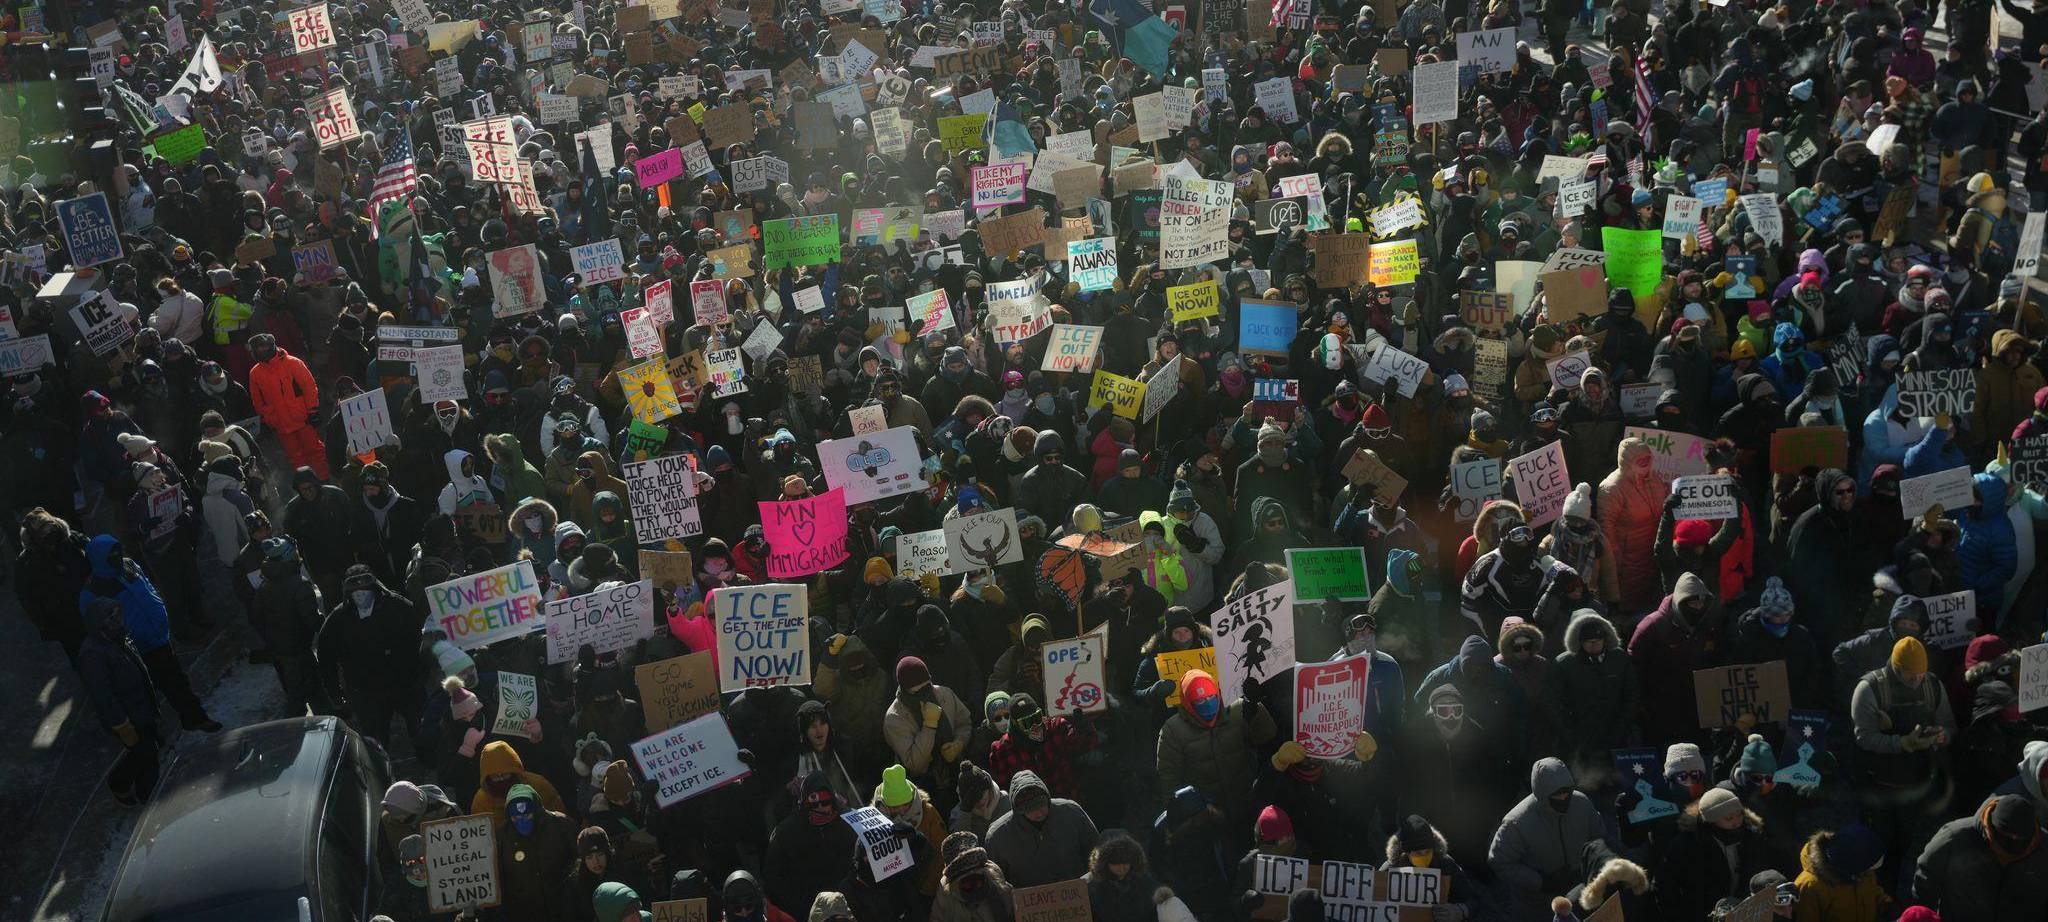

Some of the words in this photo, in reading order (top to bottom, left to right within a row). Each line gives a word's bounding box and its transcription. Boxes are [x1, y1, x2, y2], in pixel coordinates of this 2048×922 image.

[406, 8, 424, 22] FOR
[1205, 2, 1237, 12] PLEAD
[1213, 10, 1232, 21] THE
[294, 12, 325, 31] ICE
[408, 16, 429, 30] GOOD
[1472, 34, 1501, 49] MN
[280, 48, 296, 58] ICE
[92, 62, 110, 76] ICE
[936, 52, 973, 76] ICE
[1205, 72, 1222, 82] ICE
[318, 118, 352, 140] OUT!
[736, 160, 764, 173] ICE
[980, 168, 999, 181] LIKE
[1000, 166, 1014, 179] MY
[735, 169, 764, 183] OUT
[976, 177, 1006, 191] RIGHTS
[1006, 174, 1023, 187] WITH
[978, 190, 990, 201] NO
[992, 188, 1008, 199] ICE
[1167, 177, 1182, 189] NO
[1214, 182, 1226, 195] IS
[1284, 175, 1321, 198] ICE
[1216, 197, 1230, 207] ON
[1564, 192, 1581, 204] ICE
[1674, 200, 1695, 211] FIGHT
[1164, 200, 1201, 215] STOLEN
[76, 210, 99, 231] BE
[1164, 216, 1181, 226] IN
[1186, 215, 1201, 226] ON
[1204, 208, 1222, 222] IT:
[72, 225, 115, 249] BETTER
[578, 248, 593, 257] MN
[595, 244, 617, 256] NICE
[1070, 240, 1104, 255] ICE
[1164, 249, 1185, 260] NOT
[1187, 247, 1200, 258] IN
[1200, 245, 1213, 255] ON
[293, 246, 329, 268] MN
[579, 258, 598, 271] NOT
[600, 252, 622, 266] FOR
[1072, 250, 1116, 273] ALWAYS
[1560, 252, 1605, 263] FUCK
[2016, 258, 2036, 270] NO
[586, 267, 617, 283] ICE
[1073, 268, 1117, 289] MELTS
[1174, 290, 1190, 300] ICE
[1192, 286, 1211, 297] OUT
[1468, 294, 1508, 308] ICE
[81, 296, 114, 326] ICE
[1175, 296, 1214, 312] NOW!
[1466, 307, 1506, 323] OUT
[86, 322, 111, 339] OUT
[108, 316, 123, 329] OF
[90, 321, 132, 349] MINNESOTA
[994, 311, 1051, 341] TYRANNY
[1060, 326, 1094, 343] ICE
[1060, 344, 1089, 355] OUT
[1053, 356, 1090, 369] NOW!
[1379, 348, 1421, 381] FUCK
[712, 368, 743, 385] HUMAN
[714, 380, 743, 396] RIGHT
[1100, 377, 1116, 390] ICE
[1118, 382, 1137, 395] OUT
[1096, 386, 1134, 409] NOW!
[1896, 389, 1977, 418] STRONG
[2023, 450, 2041, 458] BUT
[625, 464, 646, 479] IF
[655, 456, 689, 475] YOUR
[1517, 450, 1557, 482] FUCK
[627, 476, 653, 492] VOICE
[658, 472, 682, 487] HELD
[1455, 464, 1498, 492] ICE
[1529, 469, 1562, 497] ICE
[630, 490, 646, 506] NO
[646, 484, 686, 502] POWER
[1702, 484, 1732, 498] OUT
[632, 502, 657, 516] THEY
[1523, 501, 1539, 511] YOU
[1688, 500, 1733, 510] MINNESOTA
[635, 515, 660, 530] TRY
[665, 512, 683, 525] TO
[776, 504, 816, 526] MN
[638, 525, 677, 542] SILENCE
[678, 522, 700, 536] YOU
[961, 520, 979, 535] ICE
[903, 536, 914, 546] So
[916, 530, 944, 543] Many
[432, 566, 534, 615] POWERFUL
[552, 596, 599, 618] ICE
[609, 584, 641, 604] GO
[726, 592, 792, 621] ICE
[1230, 588, 1269, 617] GET
[440, 596, 540, 642] TOGETHER
[574, 600, 634, 630] HOME
[1216, 592, 1288, 638] SALTY
[723, 622, 749, 635] GET
[752, 620, 776, 632] THE
[778, 616, 806, 628] FUCK
[735, 630, 798, 652] OUT
[1048, 646, 1080, 664] OPE
[652, 664, 682, 685] GO
[732, 650, 804, 681] NOW!
[1164, 656, 1193, 675] It's
[501, 672, 517, 685] WE
[518, 674, 535, 688] ARE
[1727, 668, 1757, 687] ICE
[2026, 669, 2041, 683] IS
[662, 680, 695, 696] HOME
[1721, 686, 1760, 706] OUT
[667, 694, 719, 721] FUCKING
[1324, 700, 1344, 712] I.C.E.
[1302, 716, 1361, 734] MINNEAPOLIS
[1318, 712, 1335, 723] OUT
[1336, 709, 1349, 721] OF
[642, 745, 662, 758] ALL
[665, 734, 687, 748] ARE
[646, 741, 707, 772] WELCOME
[654, 772, 667, 784] IN
[670, 761, 698, 779] MSP.
[1792, 772, 1818, 784] Good
[661, 777, 700, 800] EXCEPT
[702, 767, 726, 785] ICE.
[846, 807, 881, 825] JUSTICIA
[1648, 804, 1674, 815] Good
[862, 818, 882, 830] PARA
[430, 826, 453, 845] NO
[460, 824, 488, 840] ONE
[452, 840, 470, 852] IS
[870, 837, 904, 861] GOOD
[432, 853, 488, 870] ILLEGAL
[452, 864, 471, 875] ON
[438, 872, 491, 890] STOLEN
[1262, 856, 1305, 896] ICE
[1324, 862, 1374, 899] OFF
[1388, 871, 1439, 905] OUR
[441, 882, 494, 907] LAND!
[1024, 890, 1058, 908] LEAVE
